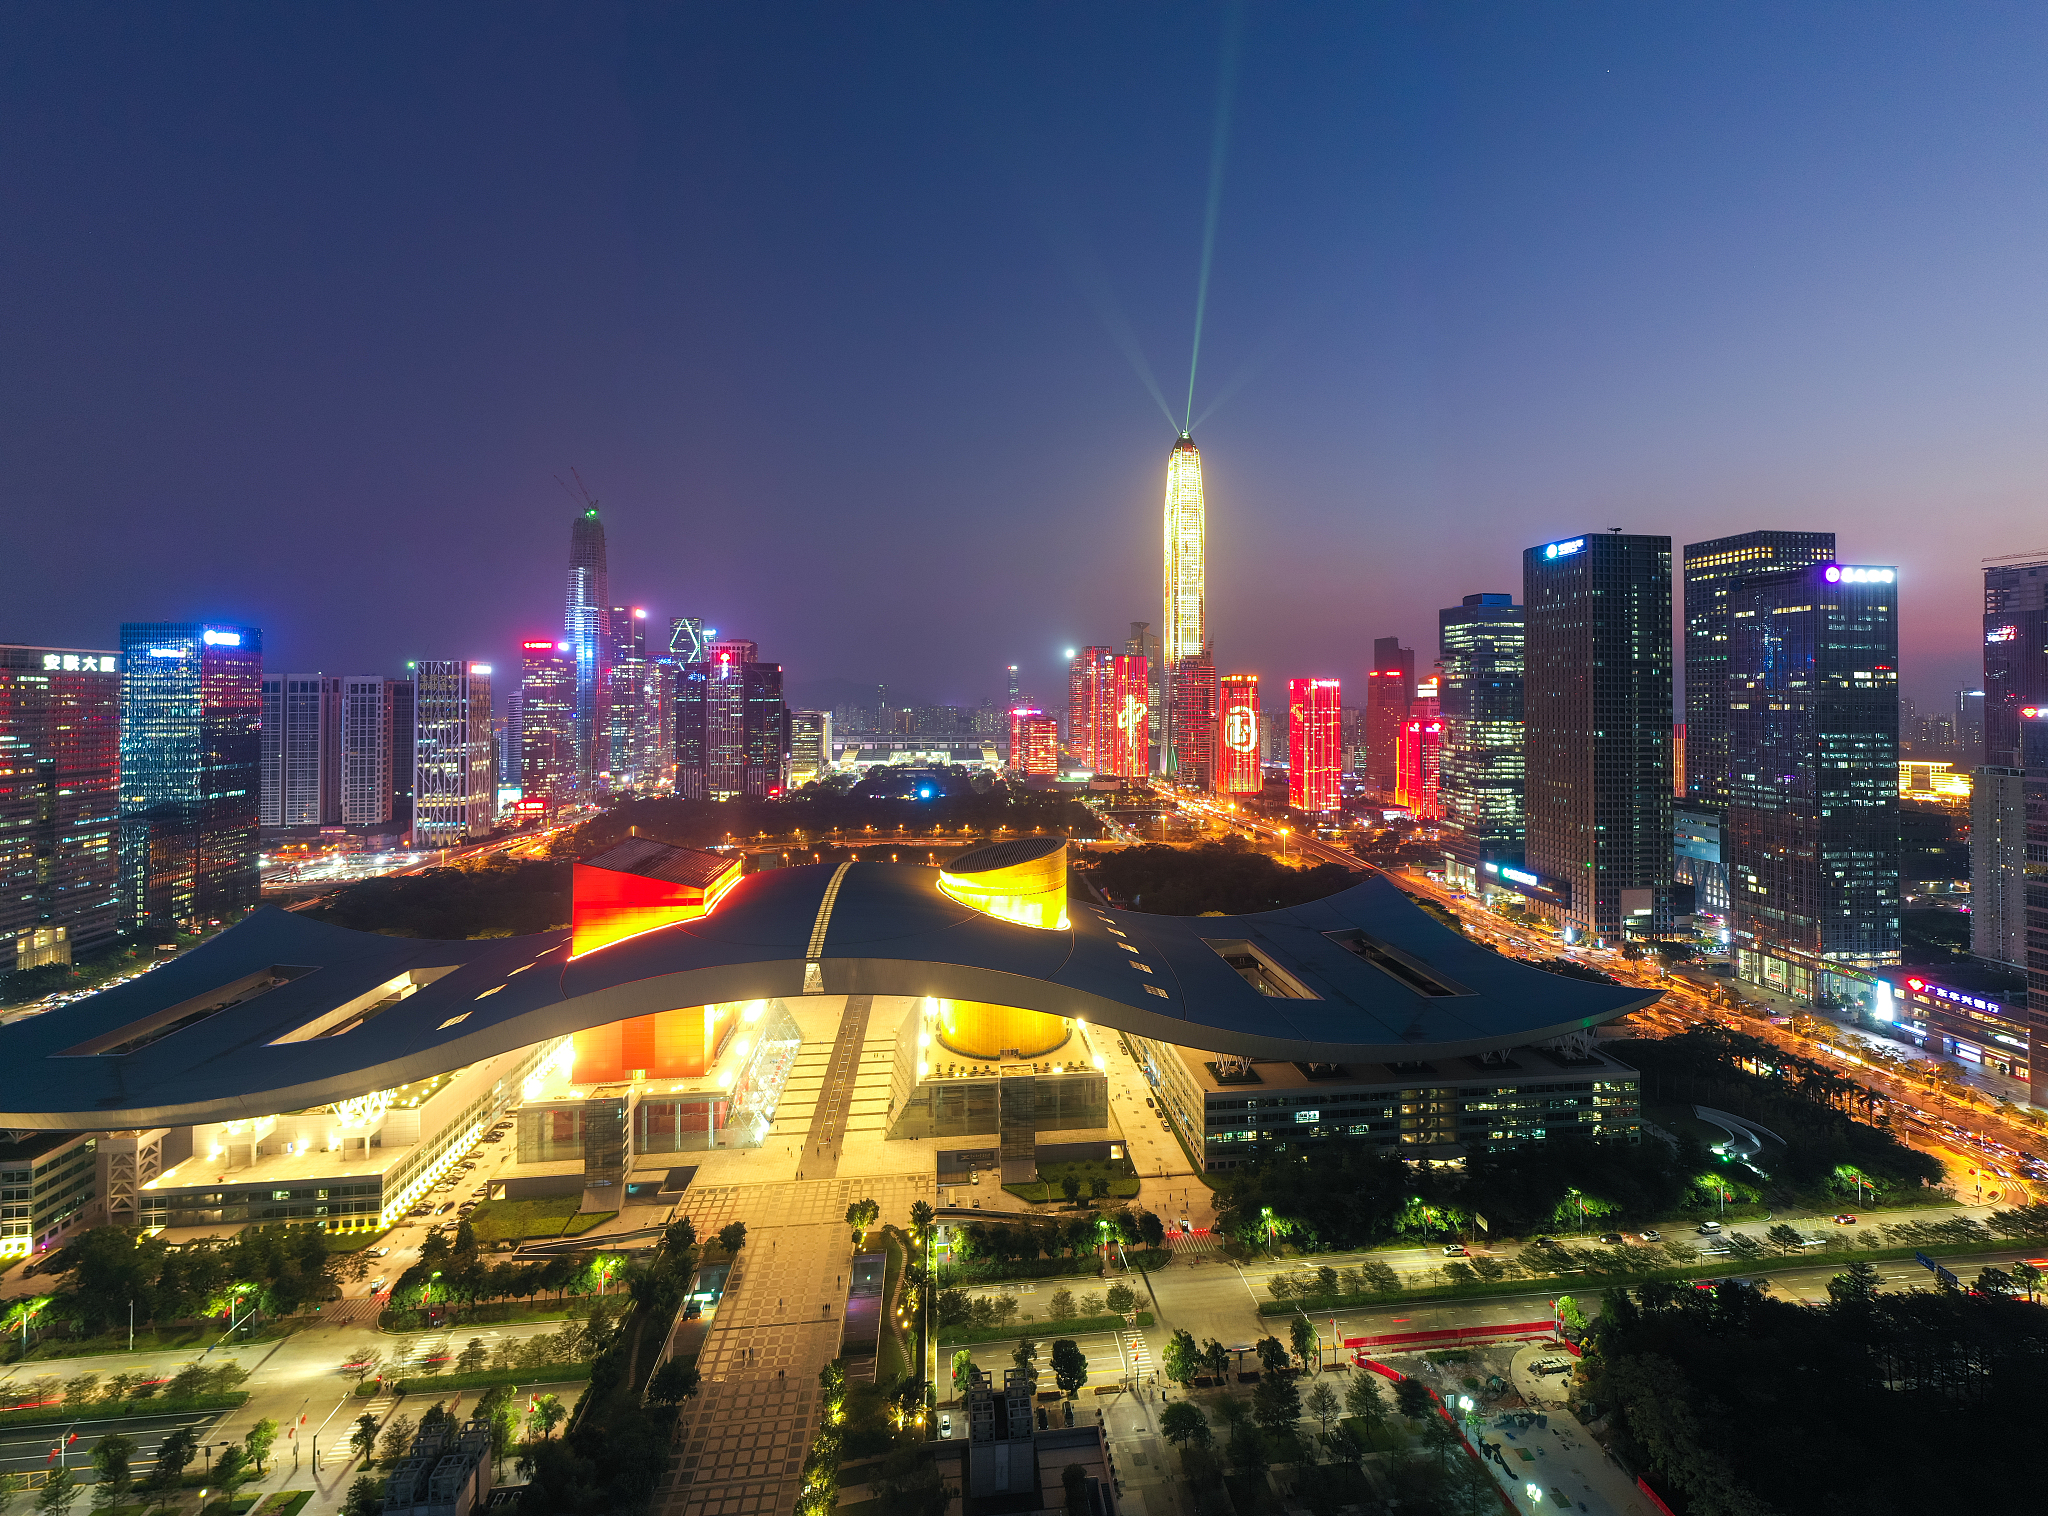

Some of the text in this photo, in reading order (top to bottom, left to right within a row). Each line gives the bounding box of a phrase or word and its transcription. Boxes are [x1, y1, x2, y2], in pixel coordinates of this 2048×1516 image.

[43, 654, 116, 673] 安联大厦
[1924, 984, 2000, 1013] 广东华兴银行
